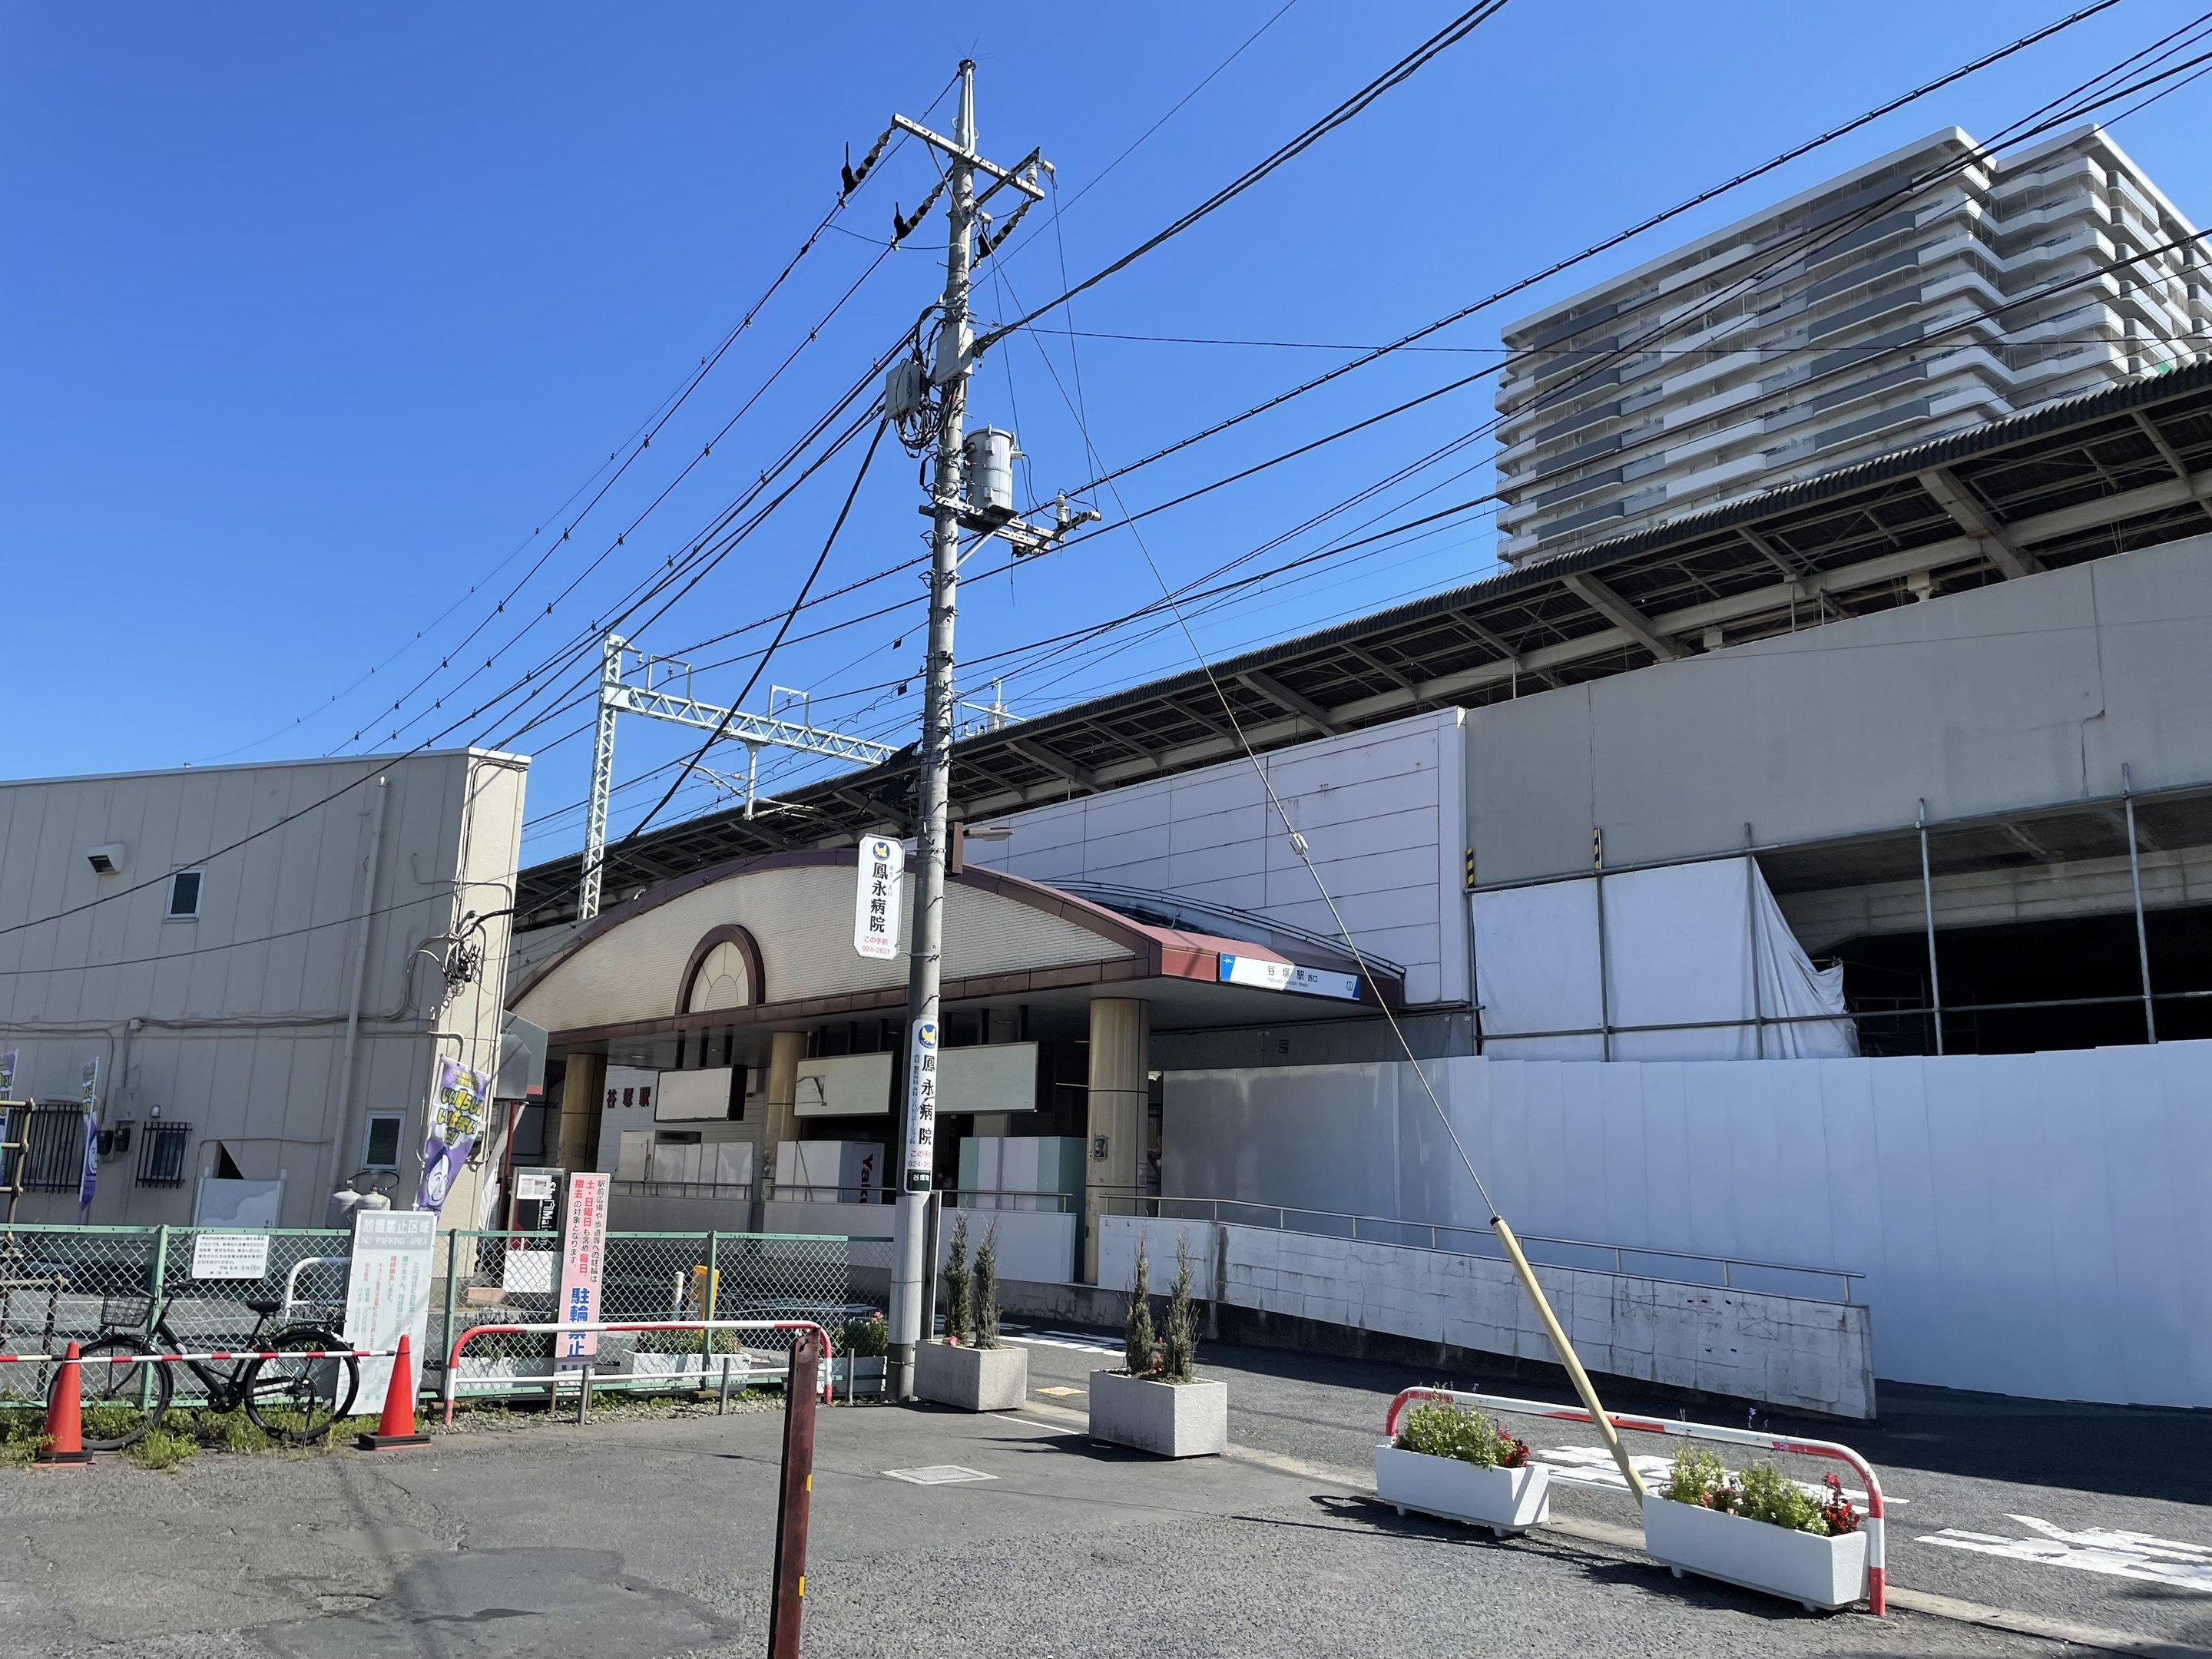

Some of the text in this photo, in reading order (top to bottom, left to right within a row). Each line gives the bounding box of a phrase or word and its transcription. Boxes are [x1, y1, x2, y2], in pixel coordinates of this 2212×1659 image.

[869, 862, 889, 932] 鳳永病院
[864, 935, 889, 945] この手前
[862, 945, 890, 955] 924-2631
[1267, 965, 1318, 983] 谷塚駅 西口
[607, 1086, 651, 1109] 谷塚駅
[919, 1055, 935, 1145] 鳳永病院
[363, 1218, 430, 1234] 放置禁止区域
[590, 1180, 605, 1283] 駅前広場や歩道等への駐輪は
[376, 1236, 405, 1245] PARKING
